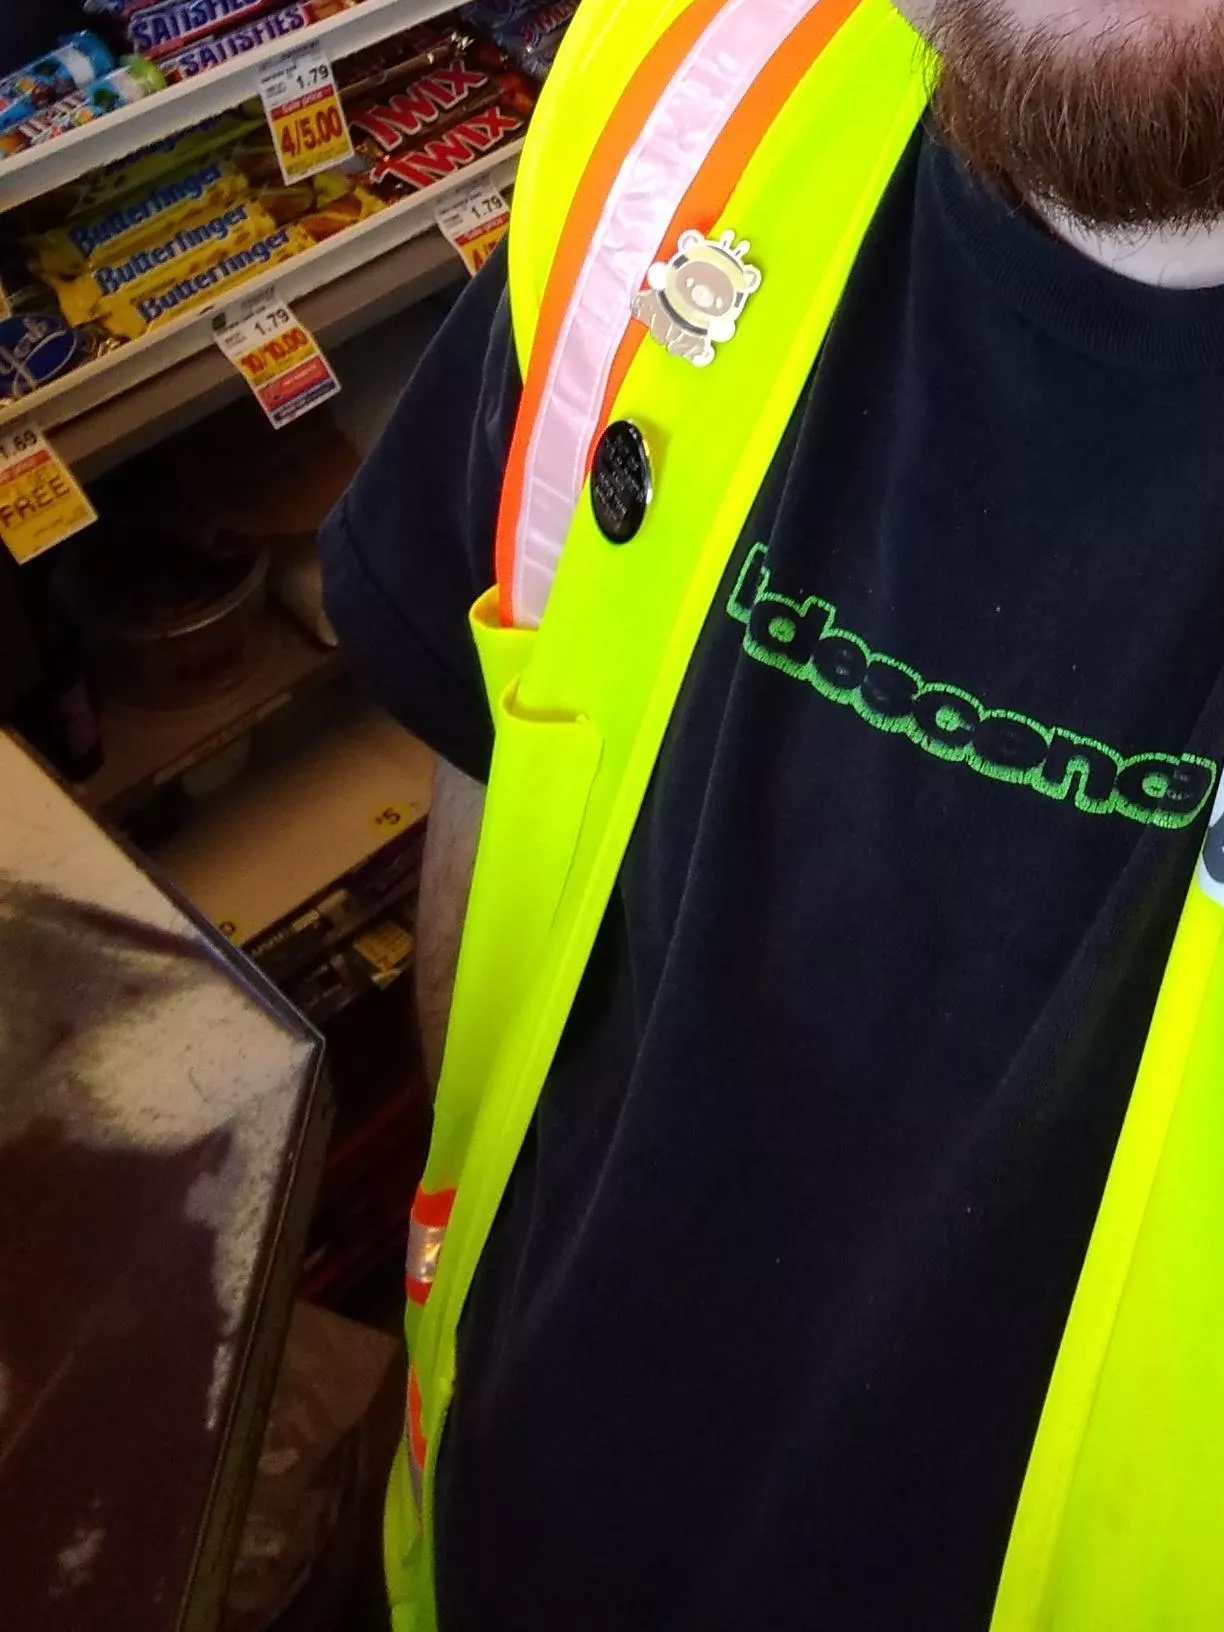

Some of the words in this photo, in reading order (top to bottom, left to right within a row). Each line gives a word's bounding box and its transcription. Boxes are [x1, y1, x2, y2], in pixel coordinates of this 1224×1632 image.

[178, 5, 307, 79] SATISFIES
[295, 63, 330, 90] 1.79
[280, 105, 343, 158] 4/5.00
[350, 59, 490, 152] TWIX
[369, 105, 525, 191] TWIX
[68, 162, 223, 259] Butterfinger
[470, 195, 504, 221] 1.79
[92, 203, 249, 297] Butterfinger
[137, 226, 290, 323] Butterfinger
[254, 307, 290, 337] 1.79
[0, 475, 71, 531] FREE
